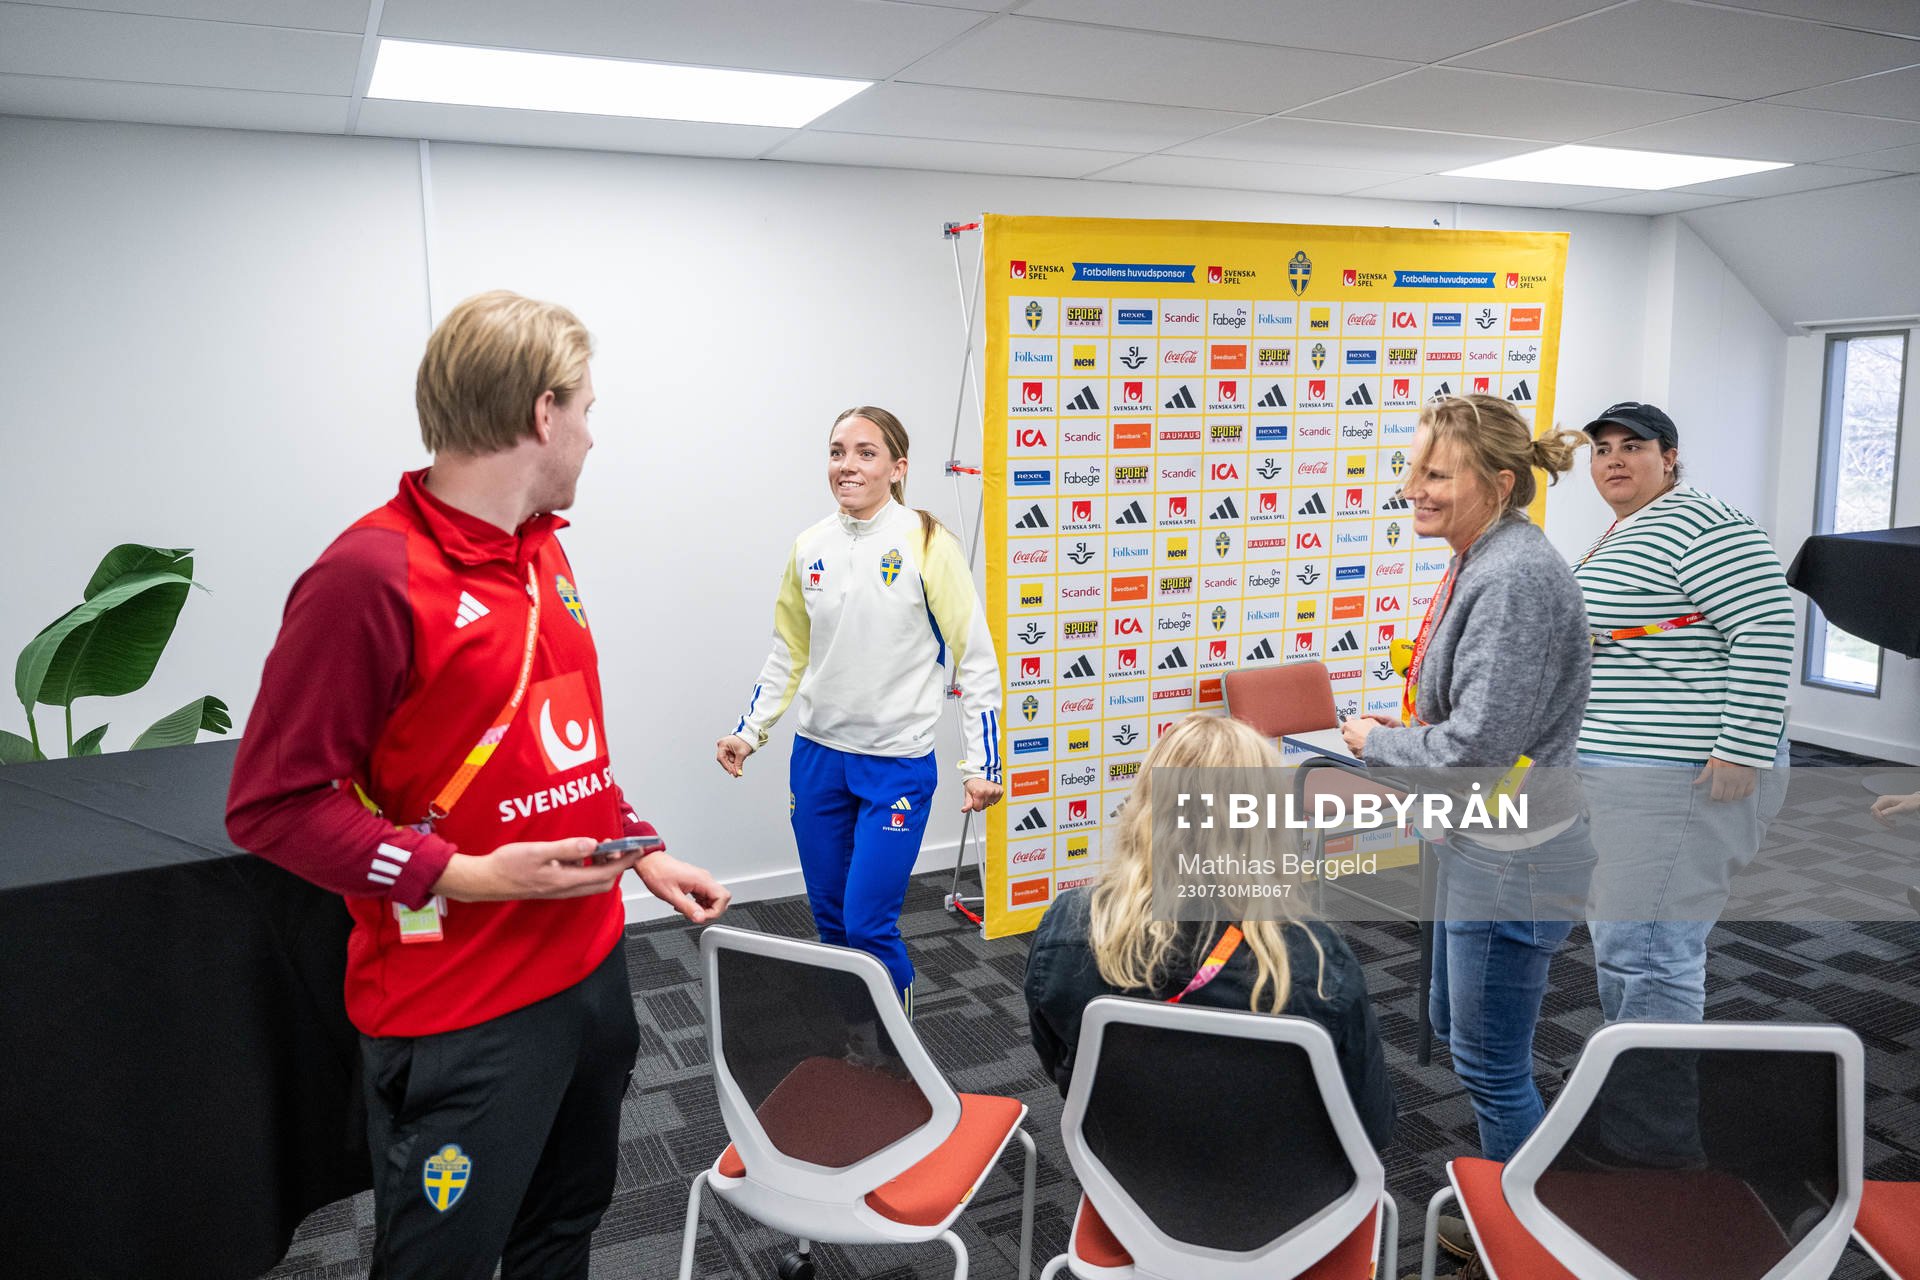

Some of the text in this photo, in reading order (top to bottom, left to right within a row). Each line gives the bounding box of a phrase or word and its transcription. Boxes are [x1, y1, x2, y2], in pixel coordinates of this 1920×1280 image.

[1029, 264, 1065, 273] SVENSKA
[1082, 267, 1185, 279] Fotbollens huvudsponsor
[1224, 269, 1256, 278] SVENSKA
[1028, 272, 1048, 280] SPEL
[1224, 277, 1241, 285] SPEL
[1402, 274, 1488, 286] Fotbollens huvudsponsor
[1357, 279, 1373, 287] SPEL
[1067, 307, 1103, 320] SPORT
[1164, 313, 1200, 323] Scandic
[1483, 308, 1491, 318] SJ
[1212, 313, 1246, 328] Fabege
[1258, 314, 1292, 324] Folksam
[1392, 312, 1417, 329] ICA
[1014, 351, 1053, 362] Folksam
[1129, 346, 1139, 357] SJ
[1258, 349, 1290, 361] SPORT
[1389, 349, 1417, 361] SPORT
[1426, 352, 1461, 360] BAUHAUS
[1469, 352, 1497, 360] Scandic
[1508, 350, 1536, 364] Fabege
[1211, 425, 1242, 438] SPORT
[1299, 427, 1331, 436] Scandic
[1342, 425, 1373, 440] Fabege
[1384, 424, 1415, 433] Folksam
[1016, 429, 1047, 447] ICA
[1064, 432, 1101, 442] Scandic
[1160, 431, 1200, 440] BAUHAUS
[1265, 458, 1274, 469] SJ
[1115, 466, 1147, 479] SPORT
[1162, 468, 1196, 478] Scandic
[1211, 464, 1238, 480] ICA
[1064, 471, 1100, 486] Fabege
[1248, 538, 1286, 548] BAUHAUS
[1296, 533, 1322, 549] ICA
[1336, 533, 1368, 543] Folksam
[1076, 542, 1087, 553] SJ
[1112, 547, 1149, 558] Folksam
[1305, 565, 1313, 575] SJ
[1415, 561, 1445, 572] Folksam
[1160, 577, 1192, 589] SPORT
[1204, 577, 1237, 588] Scandic
[1249, 574, 1280, 587] Fabege
[1062, 587, 1100, 598] Scandic
[1376, 596, 1400, 612] ICA
[1412, 595, 1433, 606] Scan
[1247, 610, 1280, 621] Folksam
[1027, 622, 1037, 633] SJ
[1064, 621, 1098, 635] SPORT
[1114, 618, 1143, 635] ICA
[1158, 616, 1191, 631] Fabege
[1380, 661, 1389, 671] SJ
[1332, 670, 1362, 680] AUHAUS
[1153, 688, 1192, 699] BAUHAUS
[1109, 694, 1144, 705] Folksam
[1368, 700, 1398, 711] Folksam
[1336, 706, 1357, 717] bege
[1121, 725, 1131, 735] SJ
[1109, 762, 1141, 776] SPORT
[1061, 772, 1095, 786] Fabege
[499, 773, 602, 822] SVENSKA
[1058, 878, 1090, 890] BAUHA
